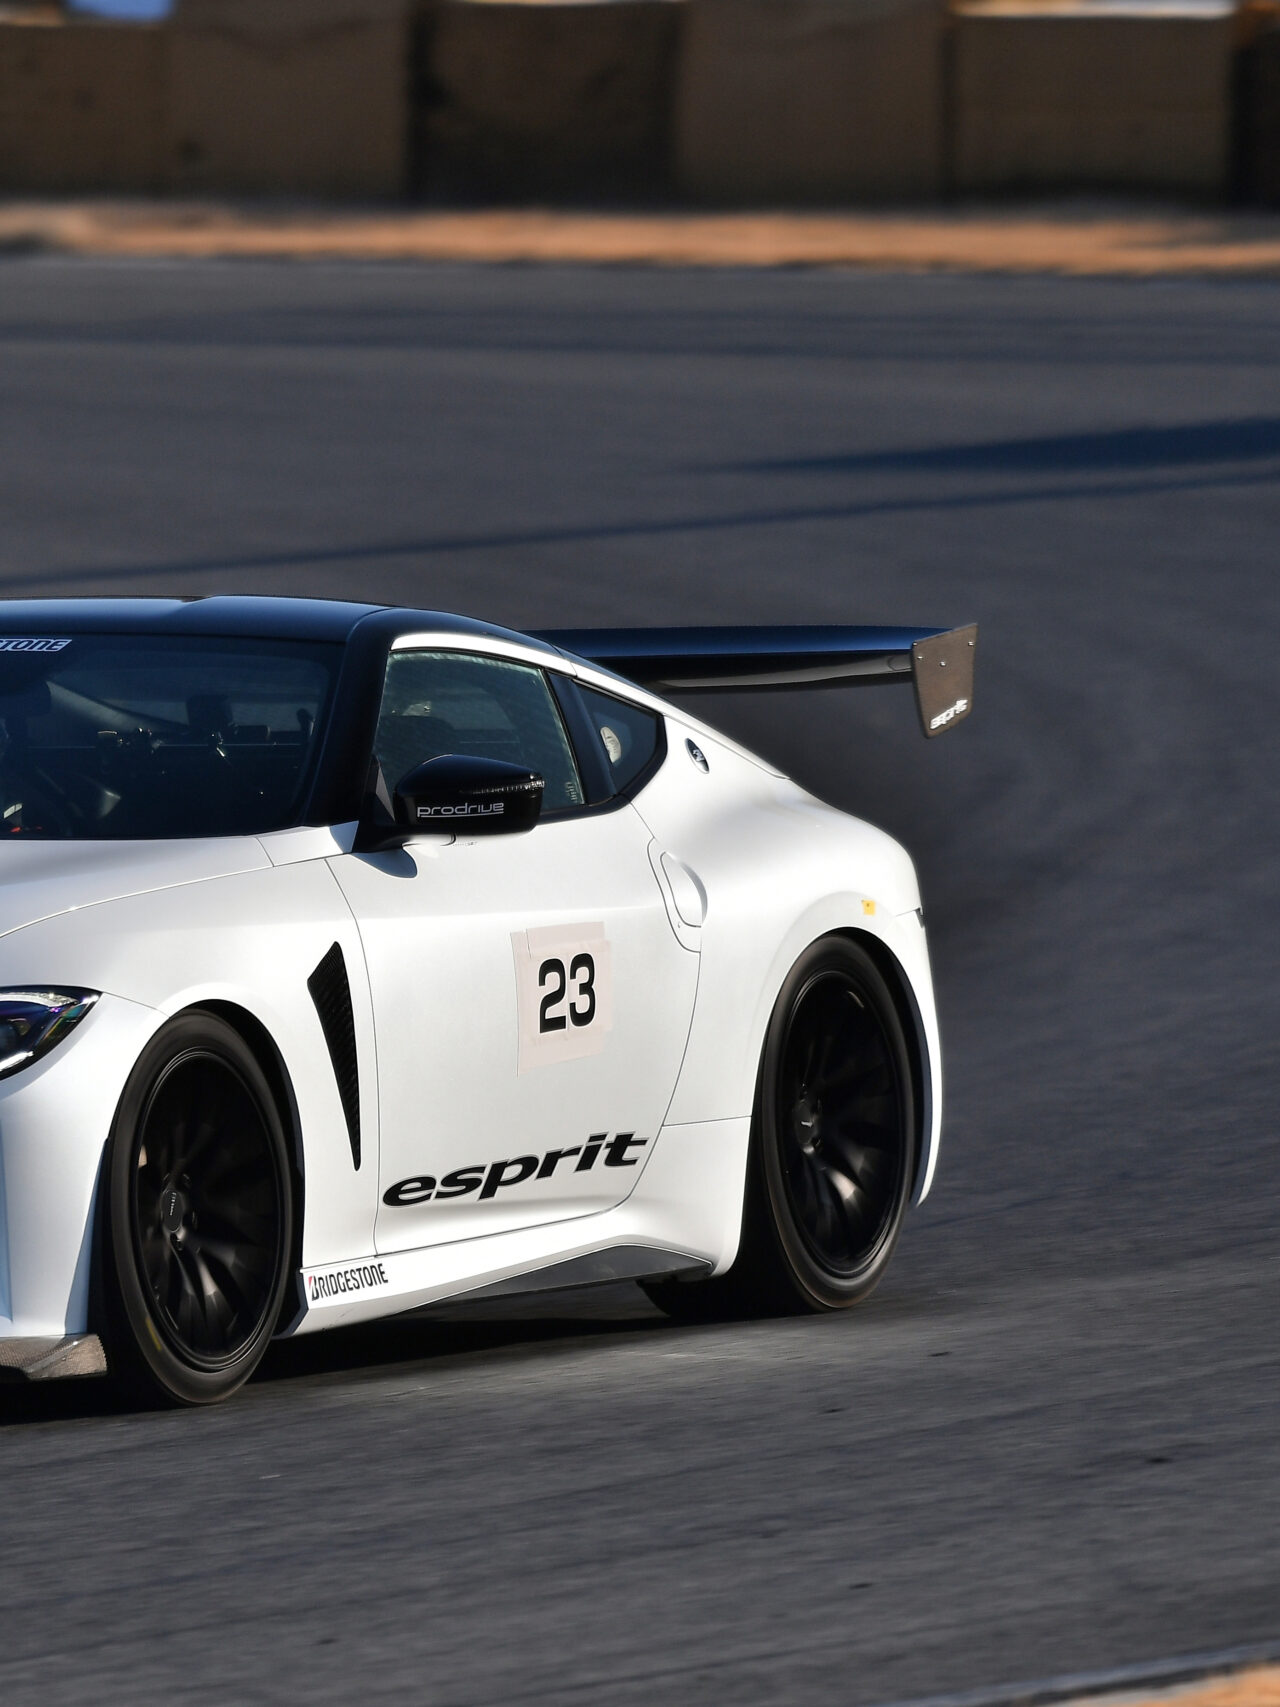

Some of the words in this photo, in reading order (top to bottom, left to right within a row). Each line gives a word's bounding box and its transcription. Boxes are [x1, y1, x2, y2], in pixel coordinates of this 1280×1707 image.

[416, 802, 505, 818] prodrive
[538, 952, 596, 1034] 23
[381, 1131, 649, 1208] esprit
[308, 1263, 389, 1301] BRIDGESTONE
